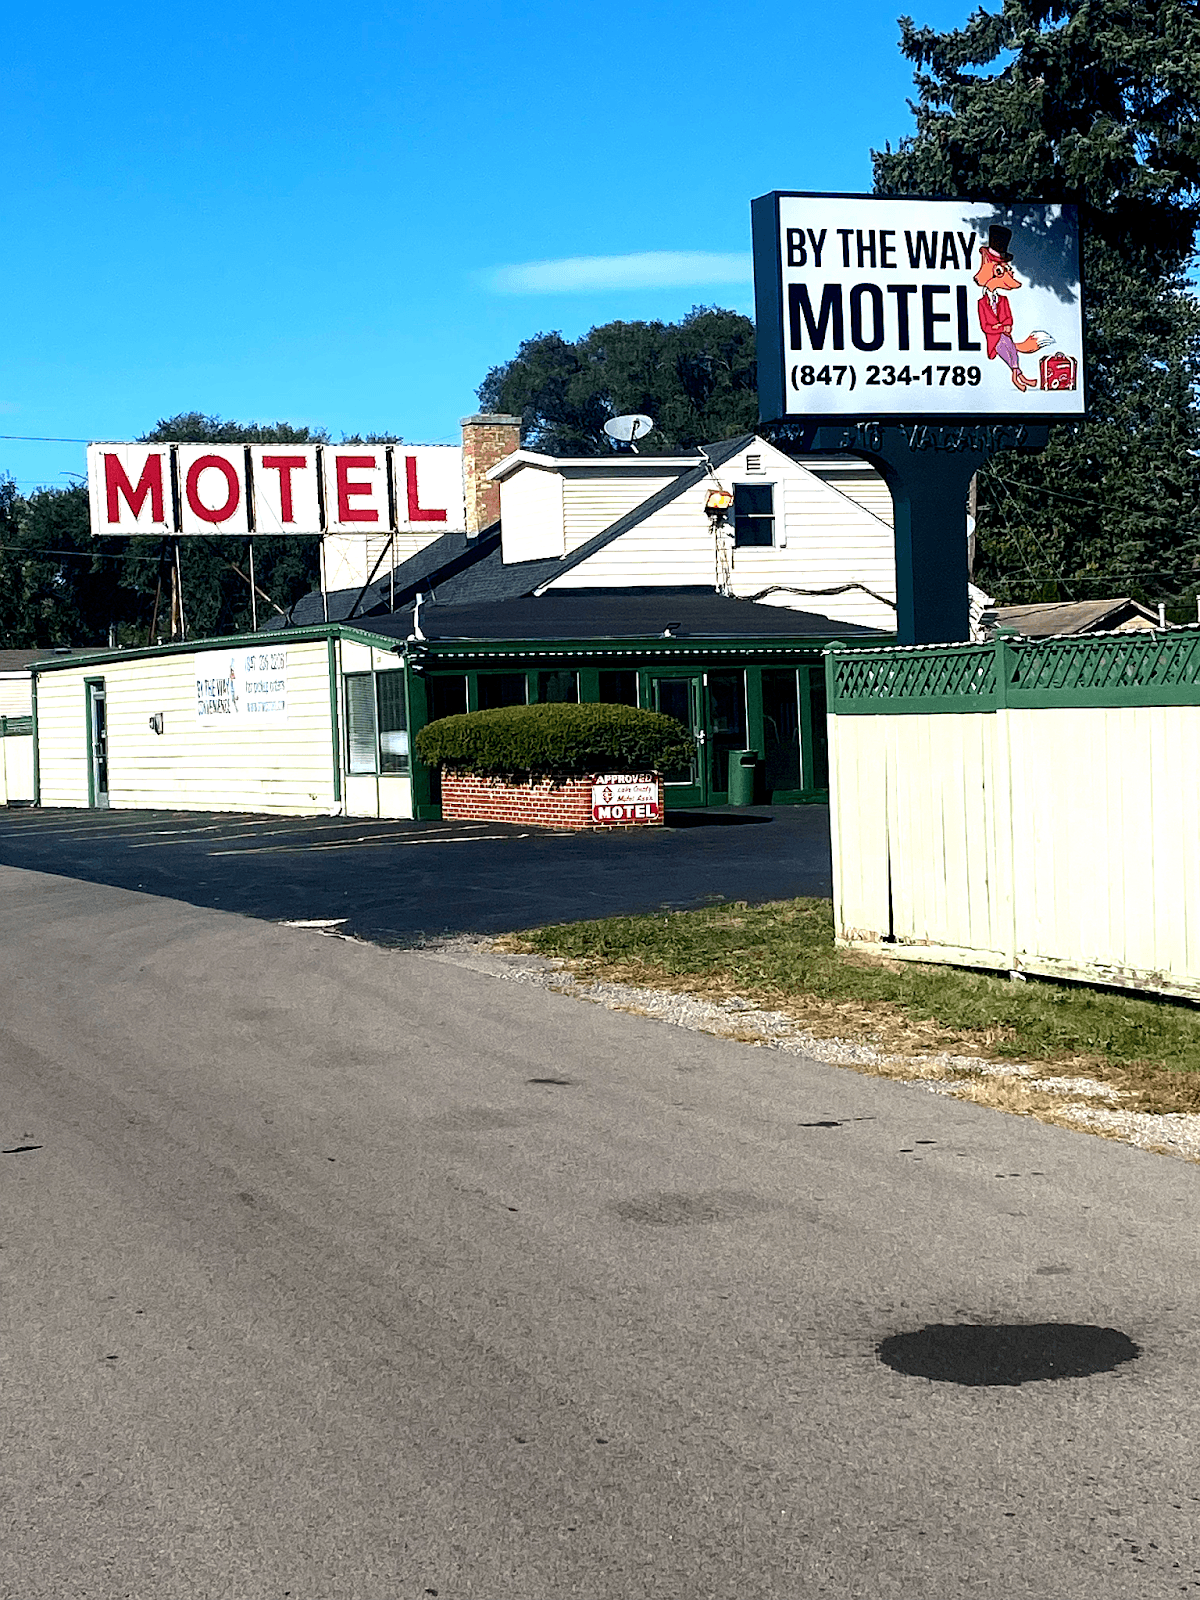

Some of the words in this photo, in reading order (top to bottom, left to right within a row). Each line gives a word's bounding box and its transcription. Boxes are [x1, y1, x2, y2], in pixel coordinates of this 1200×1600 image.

[786, 227, 827, 268] BY
[836, 228, 897, 269] THE
[904, 229, 977, 270] WAY
[788, 282, 981, 352] MOTEL
[791, 365, 857, 391] (847)
[866, 365, 982, 387] 234-1789
[104, 453, 447, 524] MOTEL
[596, 773, 653, 785] APPROVED
[598, 804, 656, 820] MOTEL
